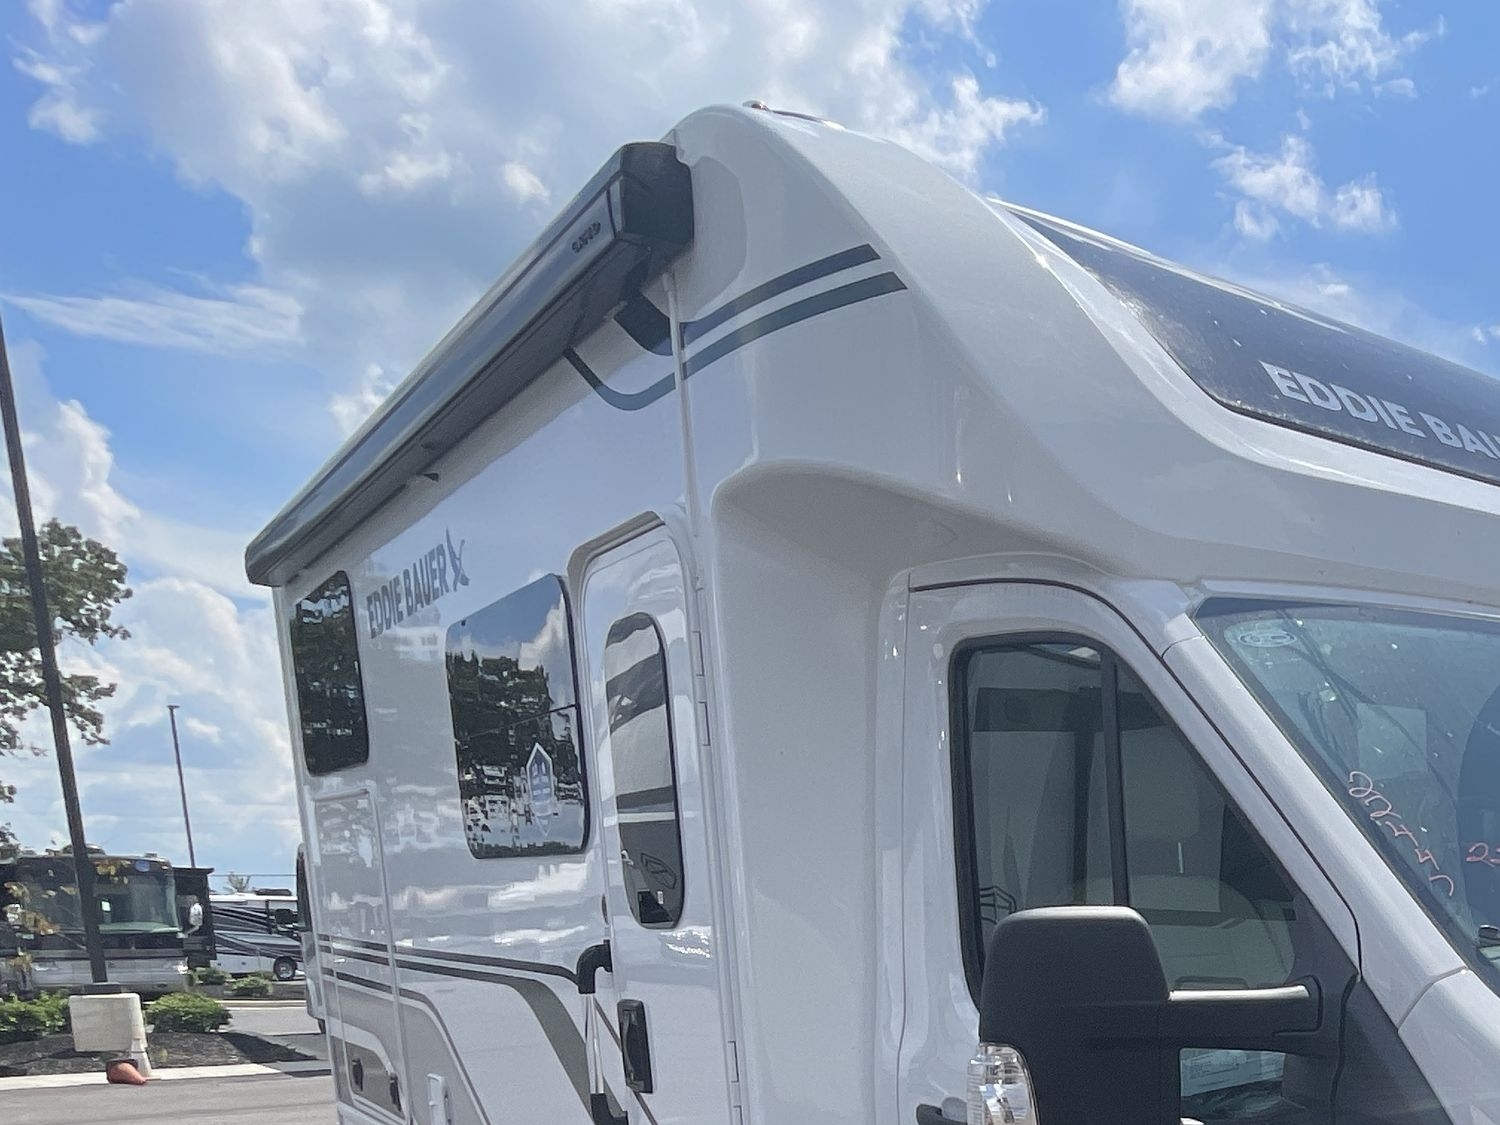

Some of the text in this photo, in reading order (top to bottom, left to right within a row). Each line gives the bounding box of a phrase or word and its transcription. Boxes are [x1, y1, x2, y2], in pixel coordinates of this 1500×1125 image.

[1258, 360, 1427, 438] EDDIE
[366, 543, 449, 639] EDDIE BAUER
